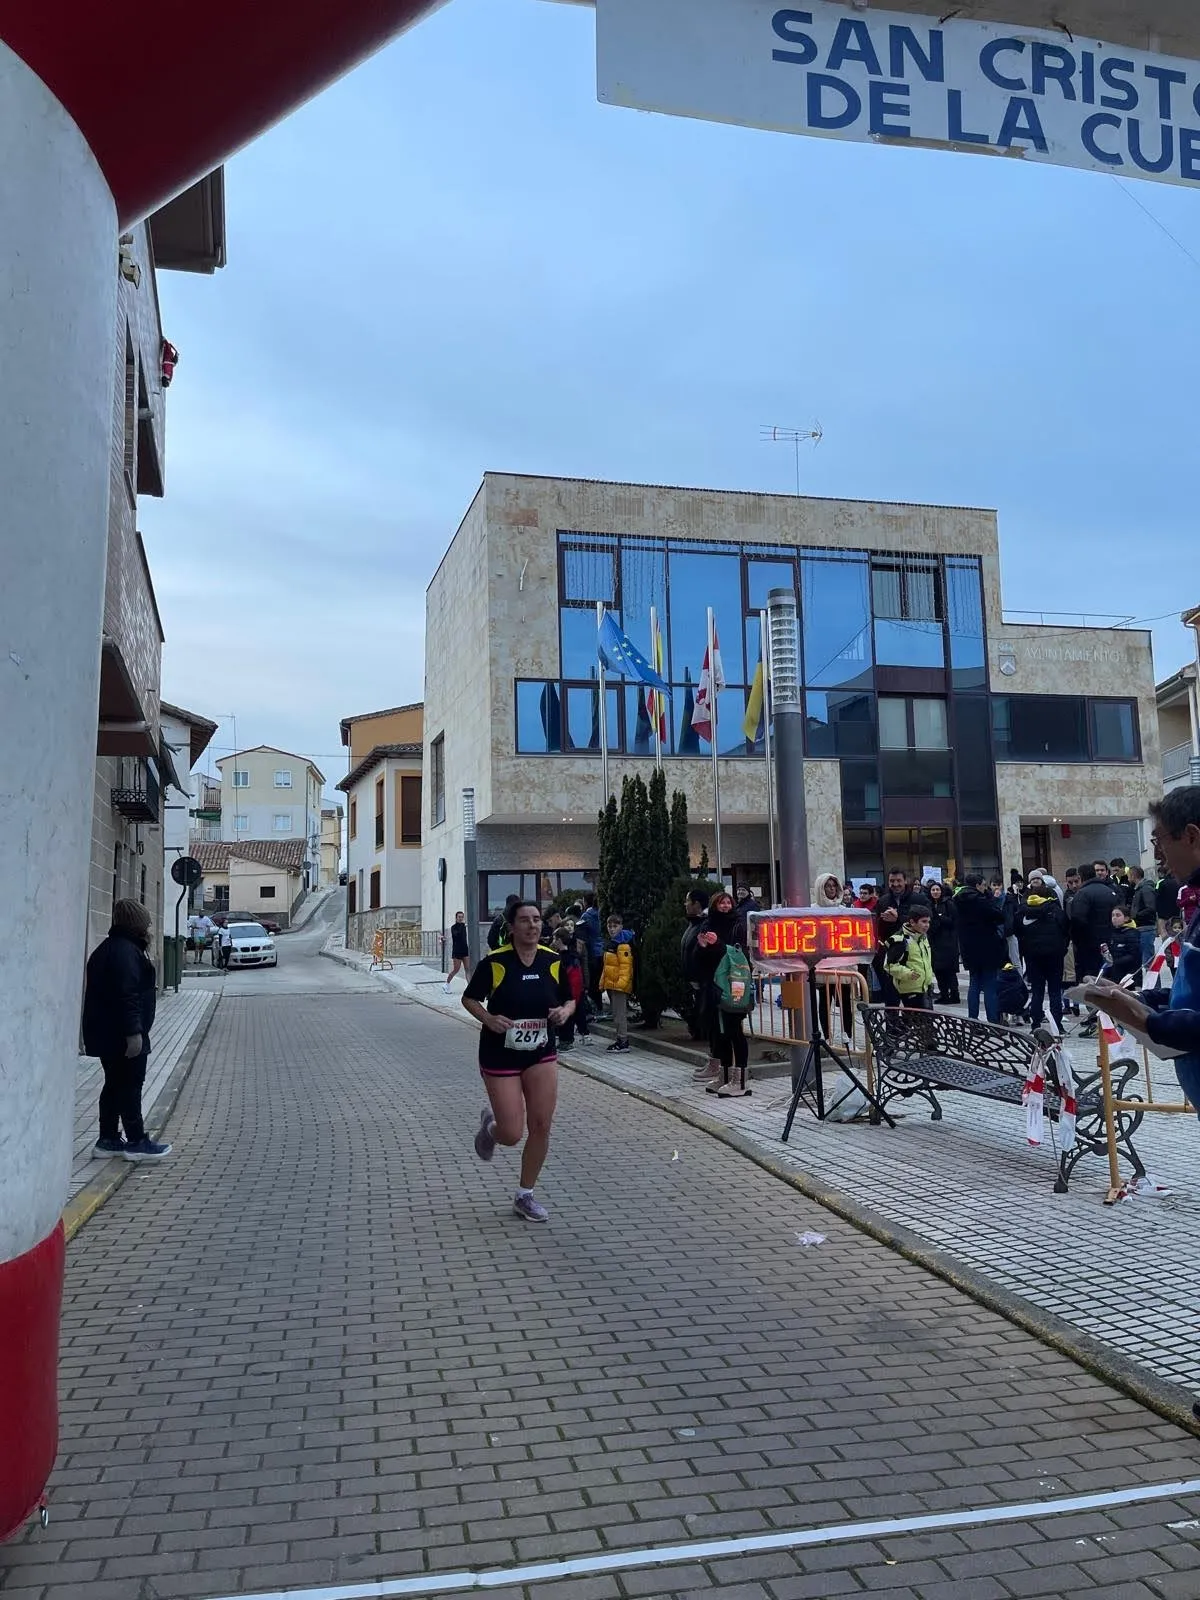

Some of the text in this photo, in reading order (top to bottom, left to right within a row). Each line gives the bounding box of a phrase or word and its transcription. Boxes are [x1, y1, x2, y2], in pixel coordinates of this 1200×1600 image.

[771, 9, 1200, 120] SAN CRIST
[807, 71, 911, 138] DE
[947, 88, 1049, 153] LA
[515, 1030, 539, 1043] 267
